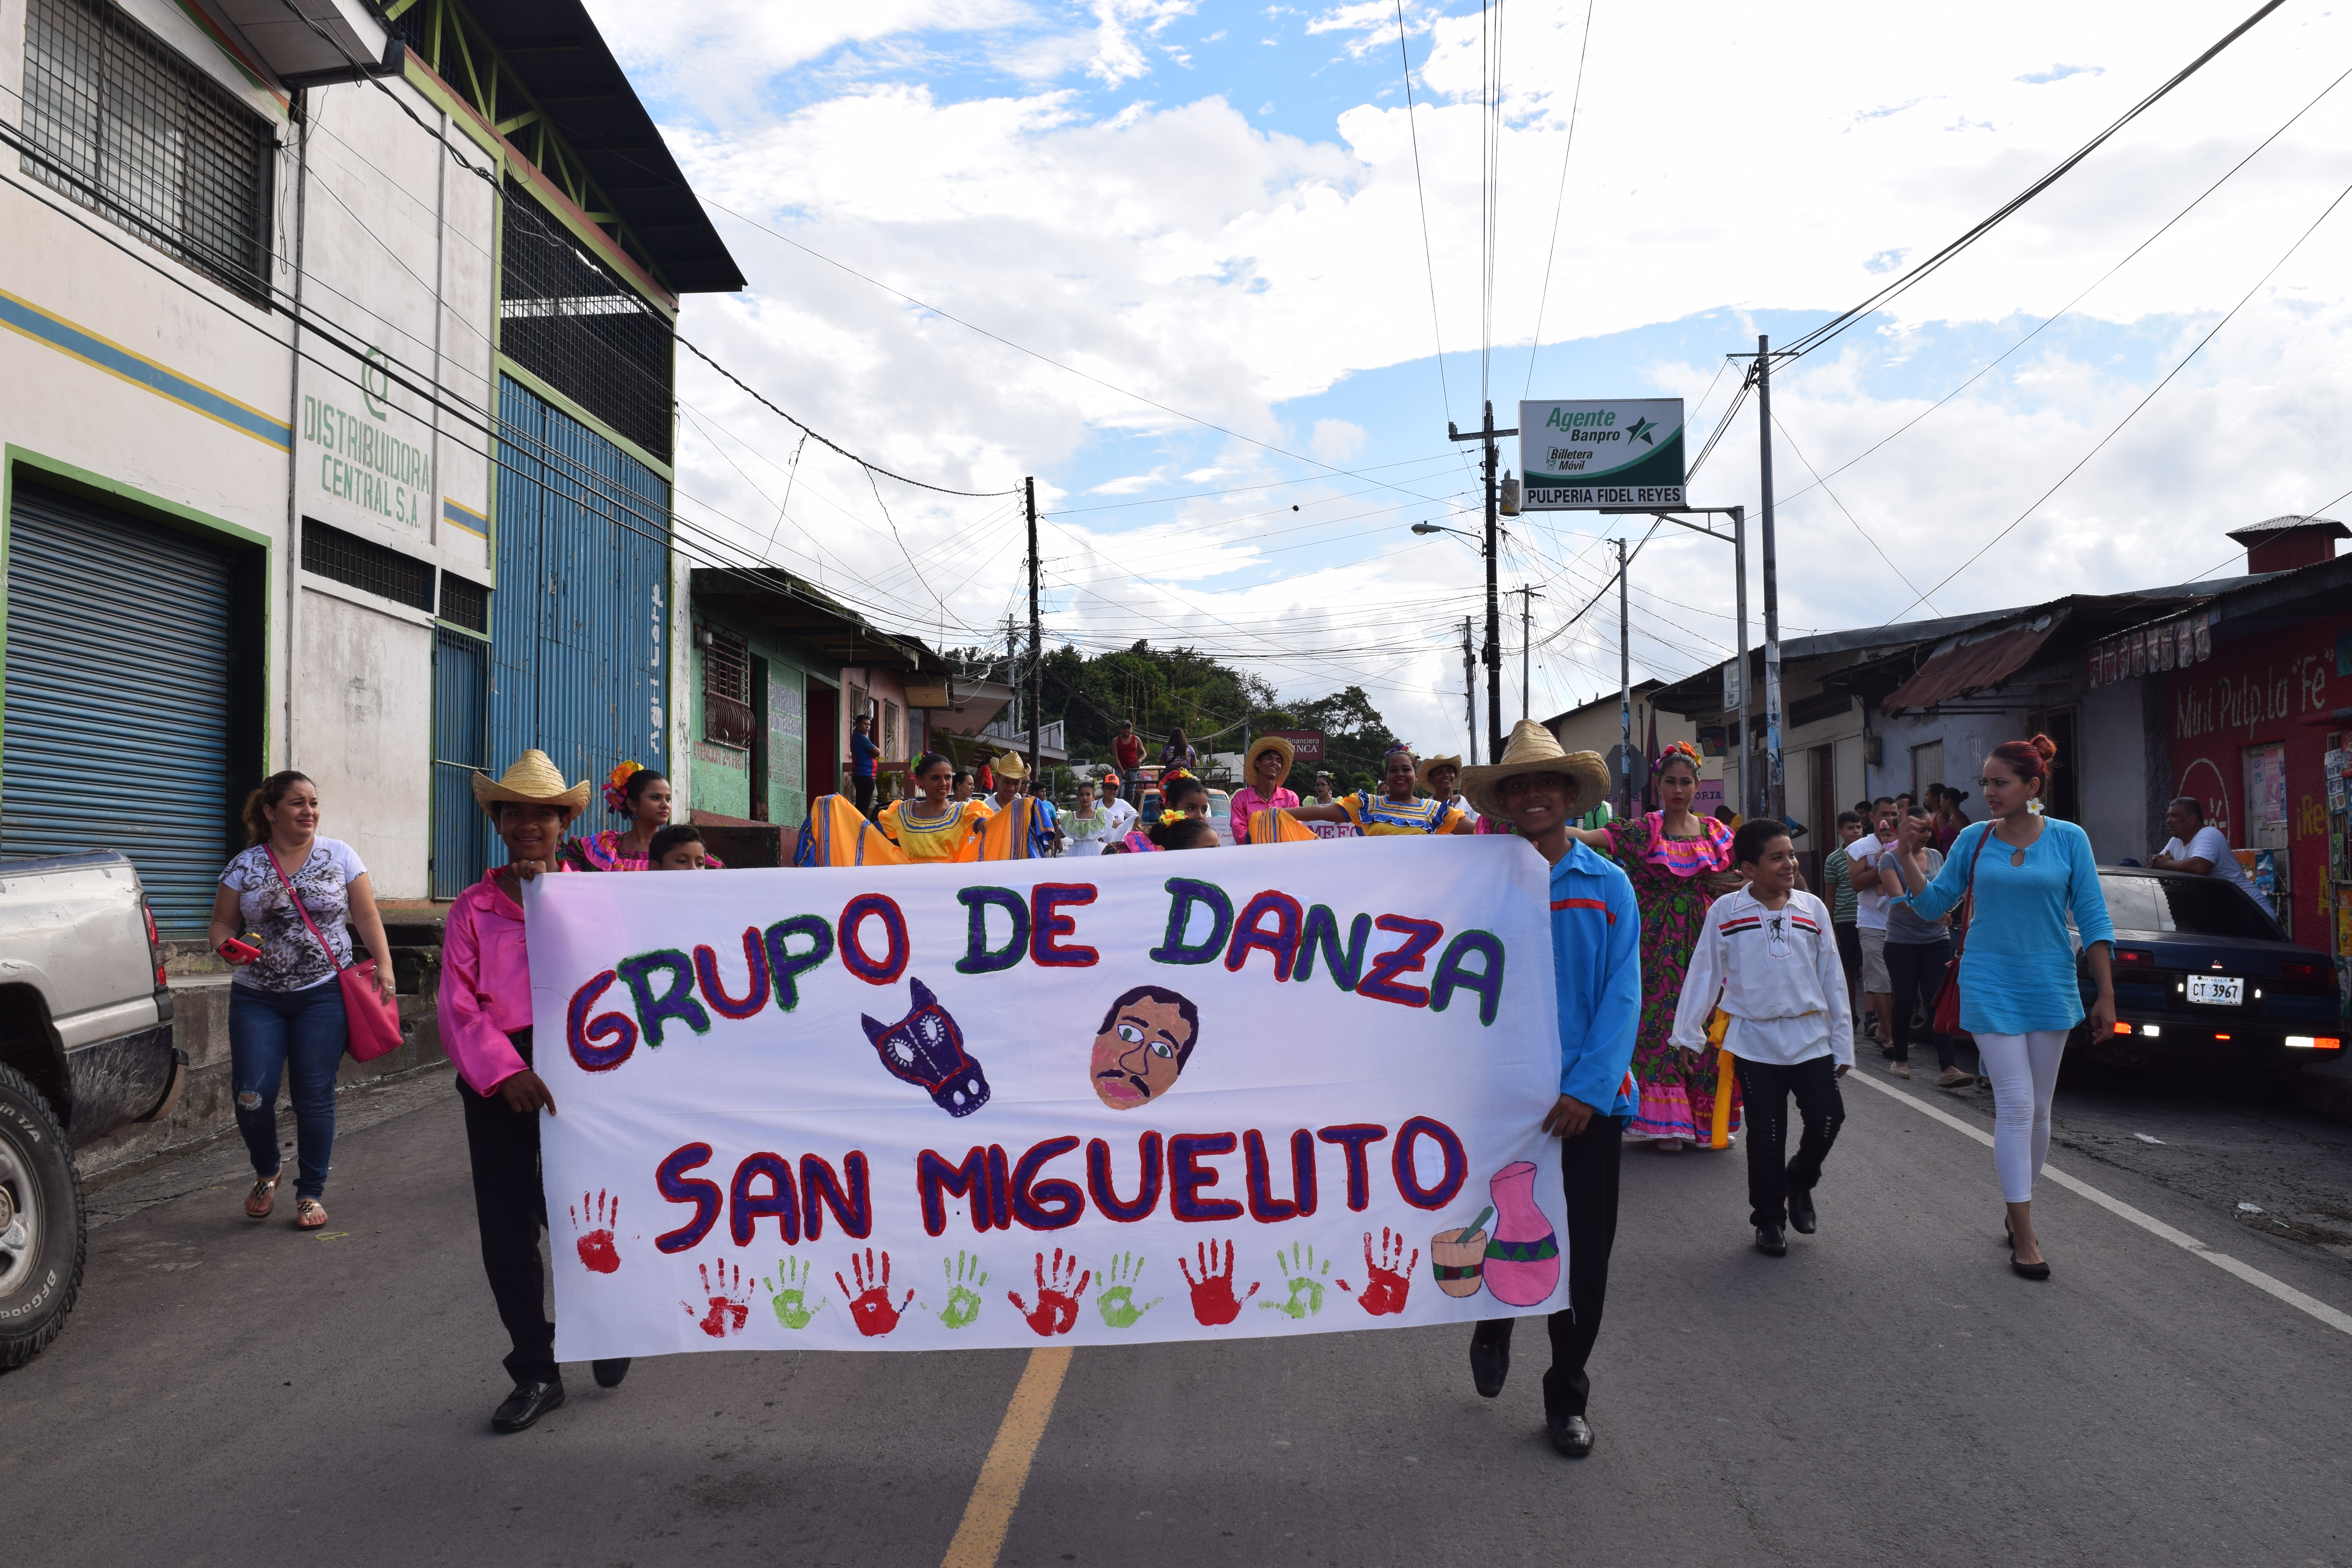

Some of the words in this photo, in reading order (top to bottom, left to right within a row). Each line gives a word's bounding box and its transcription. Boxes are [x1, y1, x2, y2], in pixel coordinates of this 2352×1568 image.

[1545, 407, 1616, 432] Agente
[304, 394, 430, 494] DISTRIBUIDORA
[1571, 429, 1620, 444] Banpro
[1550, 449, 1593, 459] Billetera
[1559, 460, 1585, 470] Móvil
[322, 454, 392, 517] CENTRAL
[396, 486, 421, 528] S.A.
[1528, 488, 1593, 504] PULPERIA
[1597, 488, 1634, 502] FIDEL
[1638, 488, 1681, 502] REYES
[2176, 685, 2214, 739] Mini
[2218, 675, 2265, 741] Pulp.
[2268, 666, 2288, 720] la
[2138, 878, 2200, 888] TOOTA
[566, 893, 910, 1073] GRUPO
[955, 882, 1099, 975] DE
[1149, 877, 1504, 1027] DANZA
[2193, 984, 2205, 996] CT
[2212, 984, 2238, 998] 3967
[18, 1114, 41, 1143] T/A
[656, 1141, 871, 1254] SAN
[916, 1116, 1469, 1236] MIGUELITO
[0, 1269, 57, 1319] BFGood
